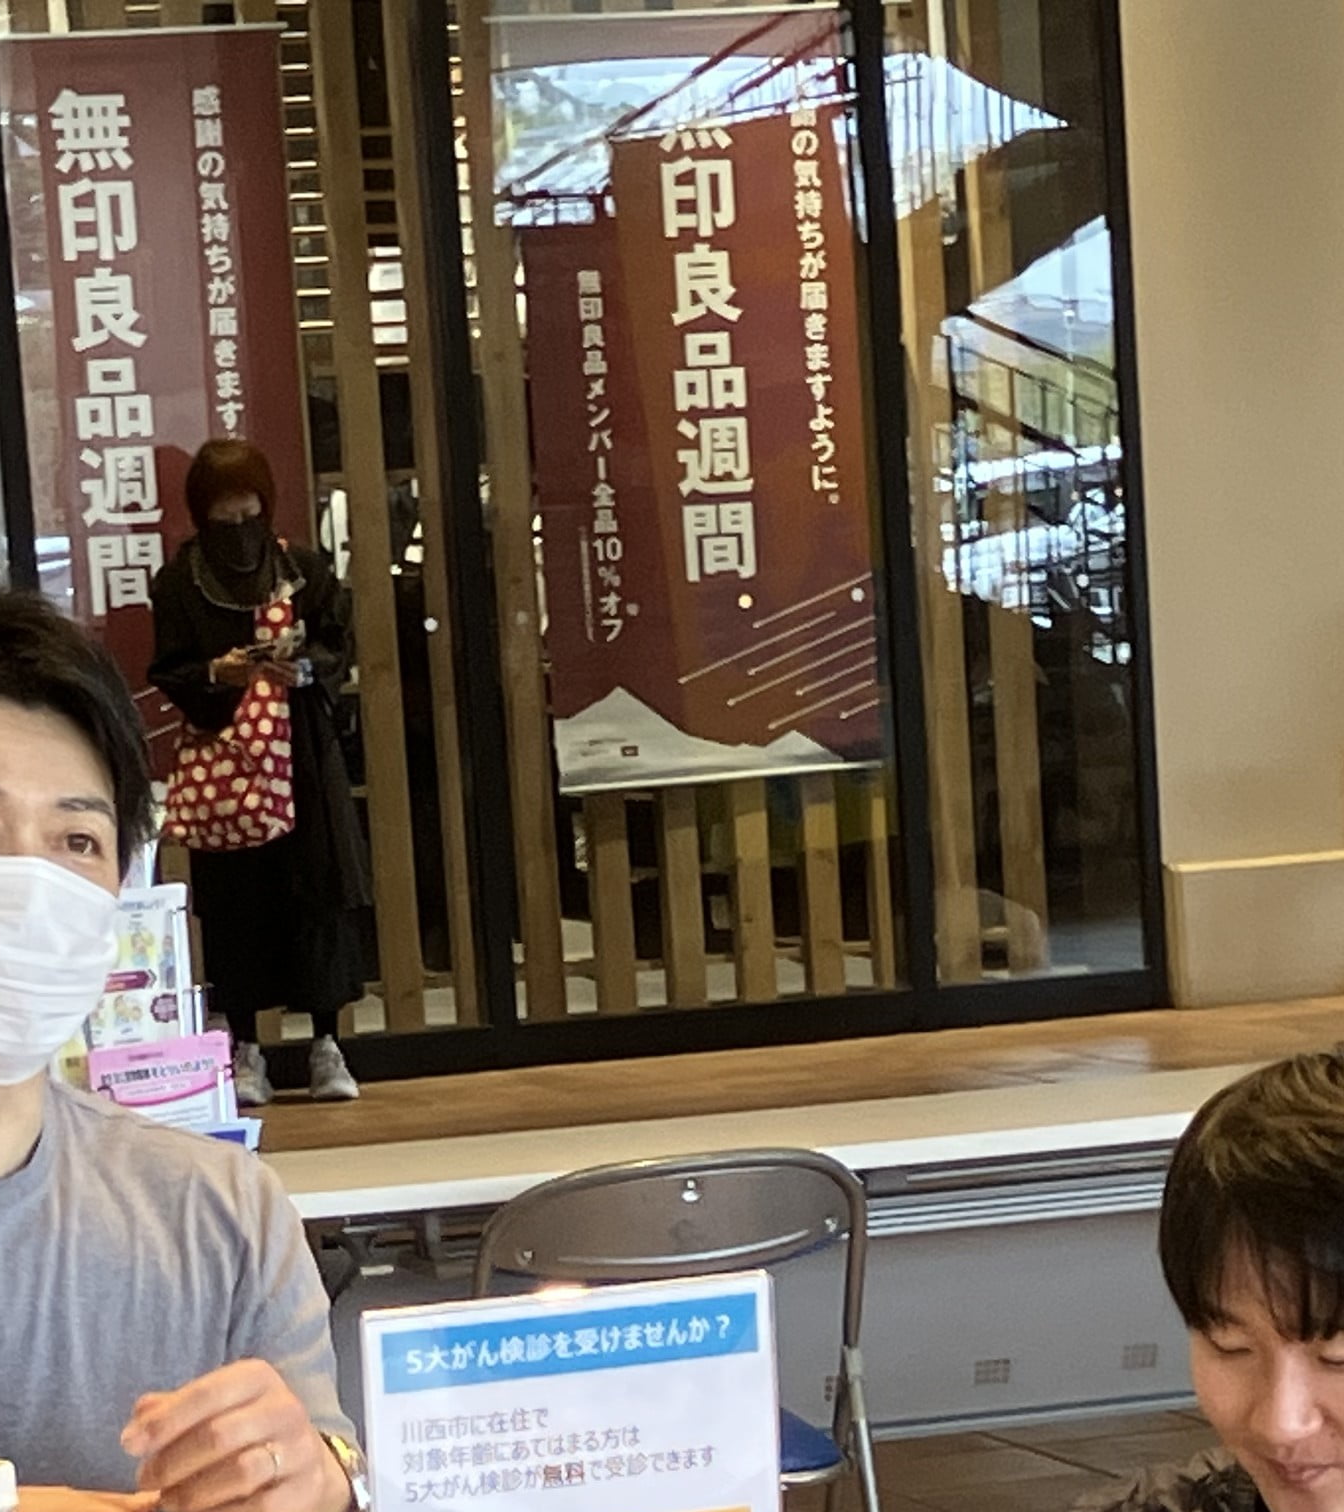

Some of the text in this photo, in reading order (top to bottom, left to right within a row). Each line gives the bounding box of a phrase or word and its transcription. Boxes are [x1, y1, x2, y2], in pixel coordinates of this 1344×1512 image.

[48, 87, 164, 617] 無印良品週間
[192, 84, 246, 438] 感謝の気持ちが届きます
[790, 106, 840, 505] 謝の気持ちが届きますように。
[401, 1407, 550, 1445] 川西市に在住で
[405, 1314, 731, 1376] 5大がん検診を受けませんか？
[403, 1426, 641, 1475] 対象年齢にあてはまる方は
